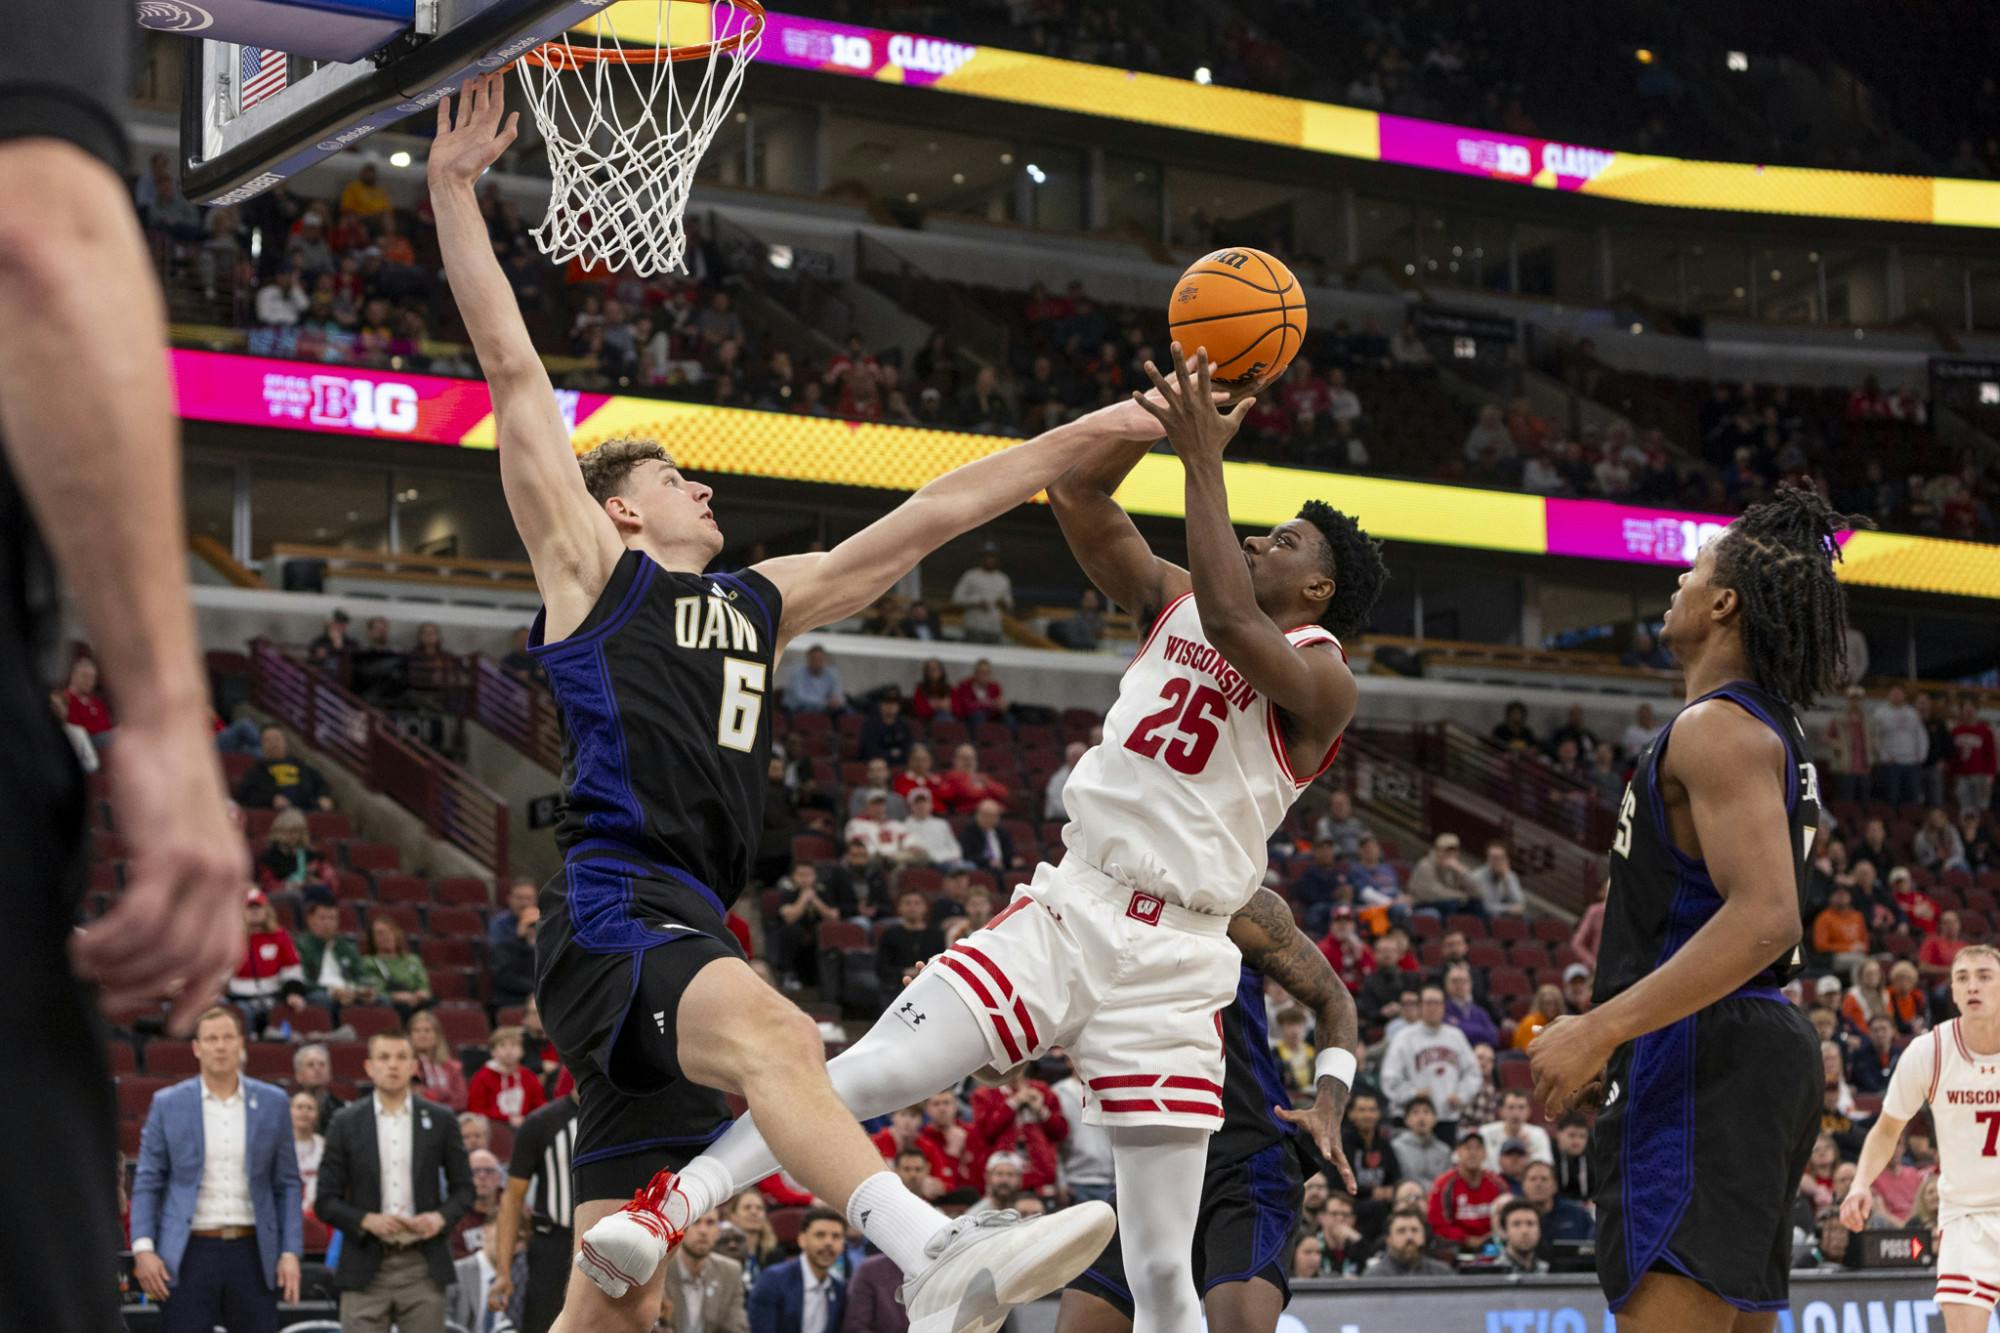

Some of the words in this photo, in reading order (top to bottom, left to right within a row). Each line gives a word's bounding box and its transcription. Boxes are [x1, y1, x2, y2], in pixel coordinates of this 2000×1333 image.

[718, 656, 766, 753] 6
[1163, 634, 1258, 713] WISCONSIN
[1123, 677, 1228, 775] 25
[1975, 1111, 2000, 1156] 7
